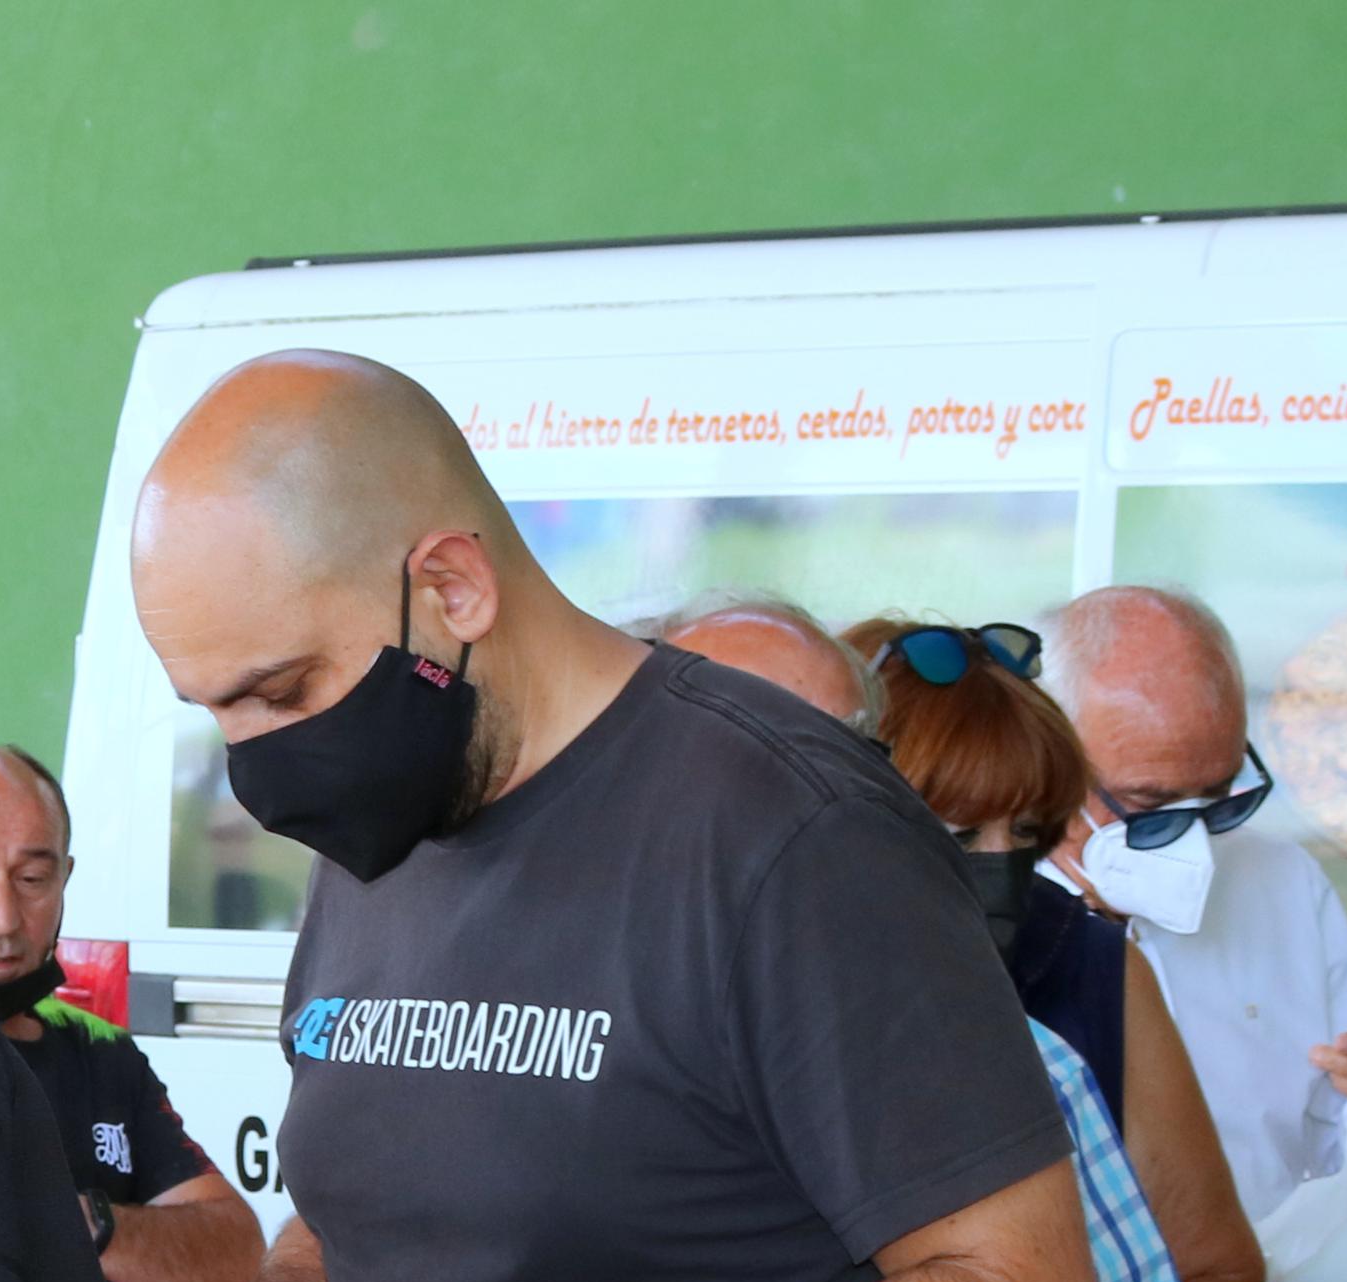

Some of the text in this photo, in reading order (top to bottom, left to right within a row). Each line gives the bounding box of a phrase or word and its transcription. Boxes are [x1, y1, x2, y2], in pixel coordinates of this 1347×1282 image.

[506, 400, 538, 450] al
[538, 400, 622, 449] hierro
[629, 396, 659, 446] de
[665, 407, 789, 449] terneros,
[796, 388, 894, 444] cerdos,
[900, 396, 995, 462] potros
[996, 403, 1022, 460] y
[1127, 375, 1271, 443] Paellas,
